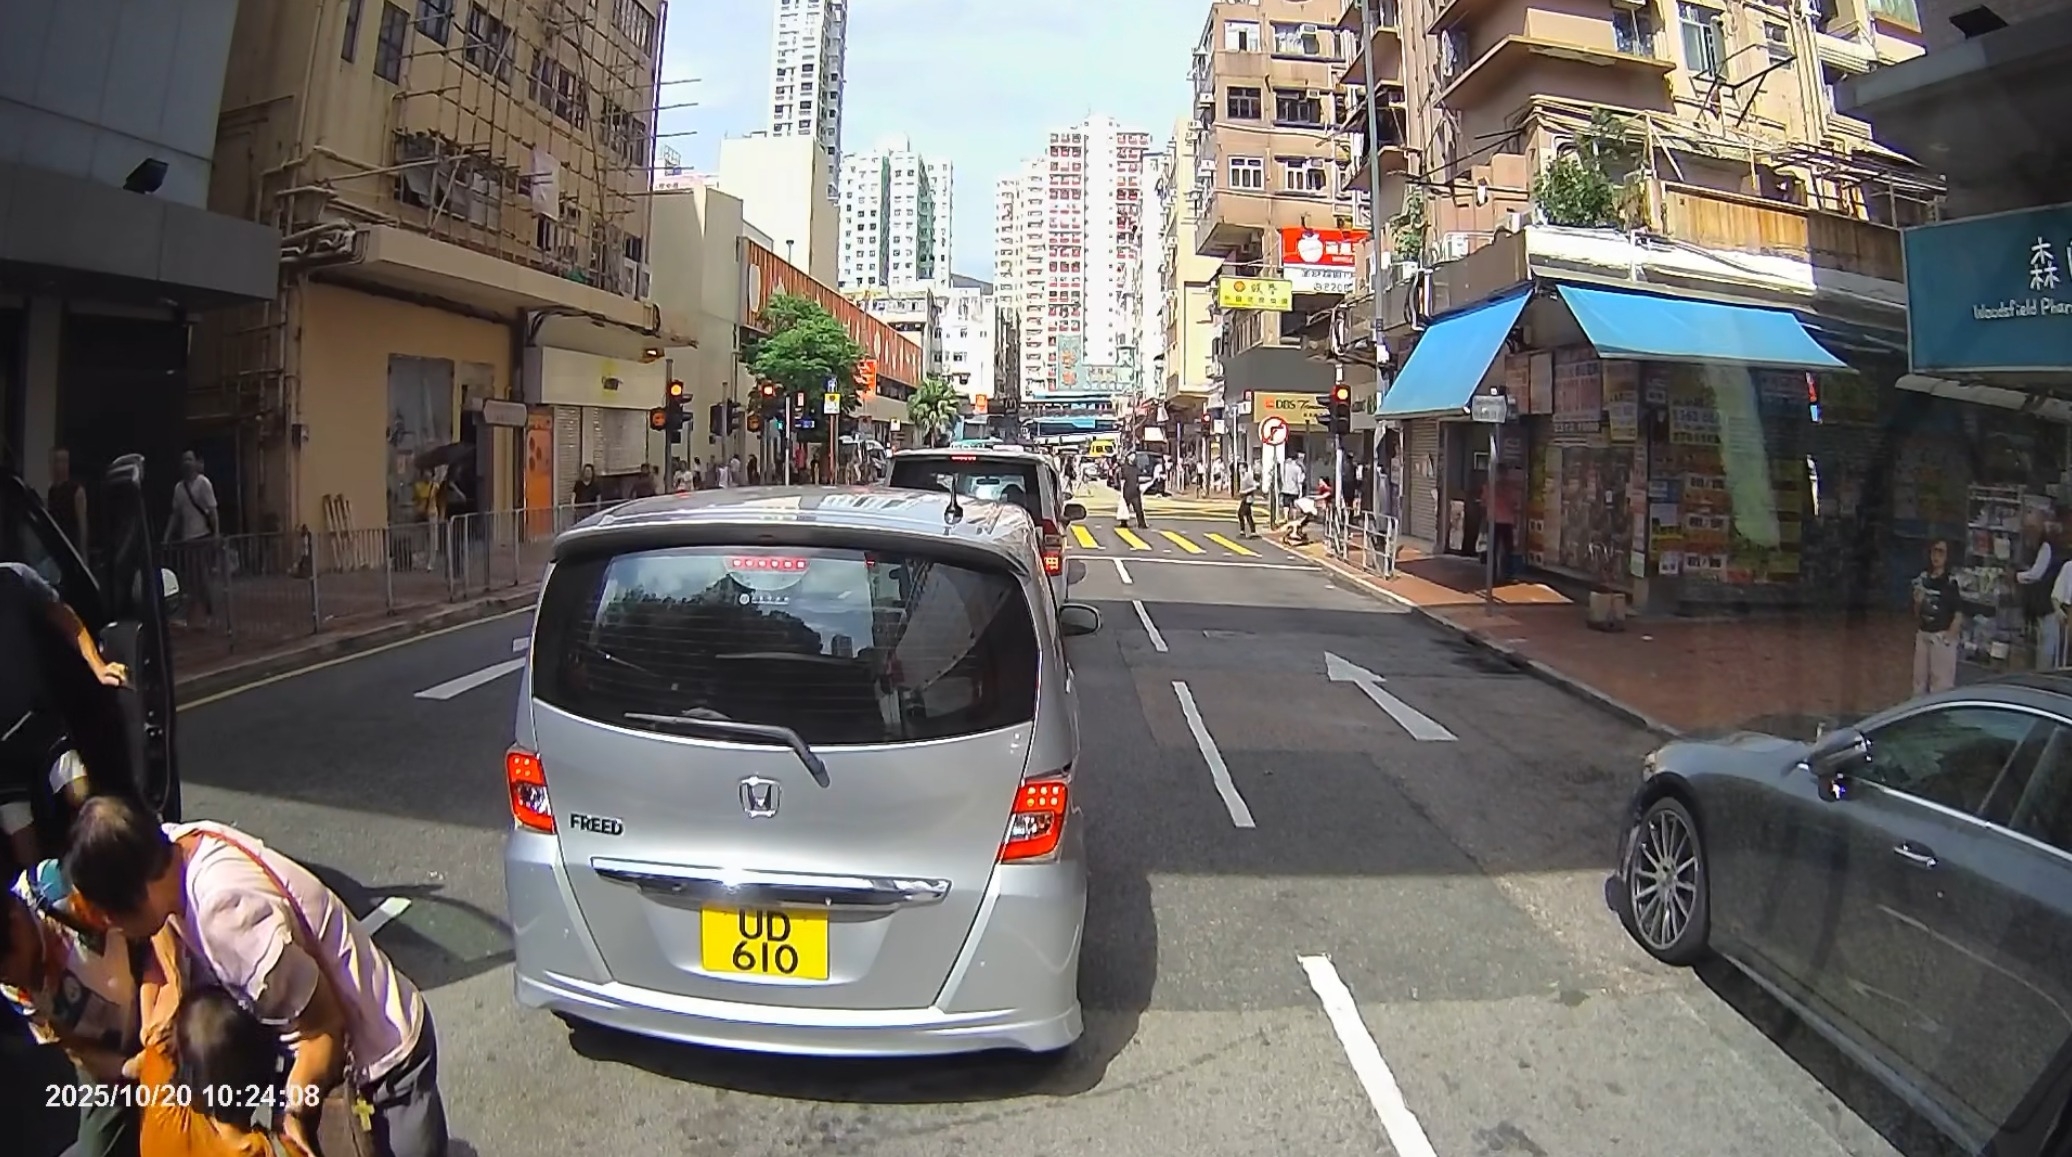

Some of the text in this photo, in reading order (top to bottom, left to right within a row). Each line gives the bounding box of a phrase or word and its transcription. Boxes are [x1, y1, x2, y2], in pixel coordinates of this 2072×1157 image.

[2029, 236, 2072, 290] 森
[1972, 299, 2037, 319] Woodsfield
[1275, 399, 1296, 409] DBS
[570, 813, 625, 836] FREED
[738, 909, 791, 942] UD
[732, 941, 799, 975] 610
